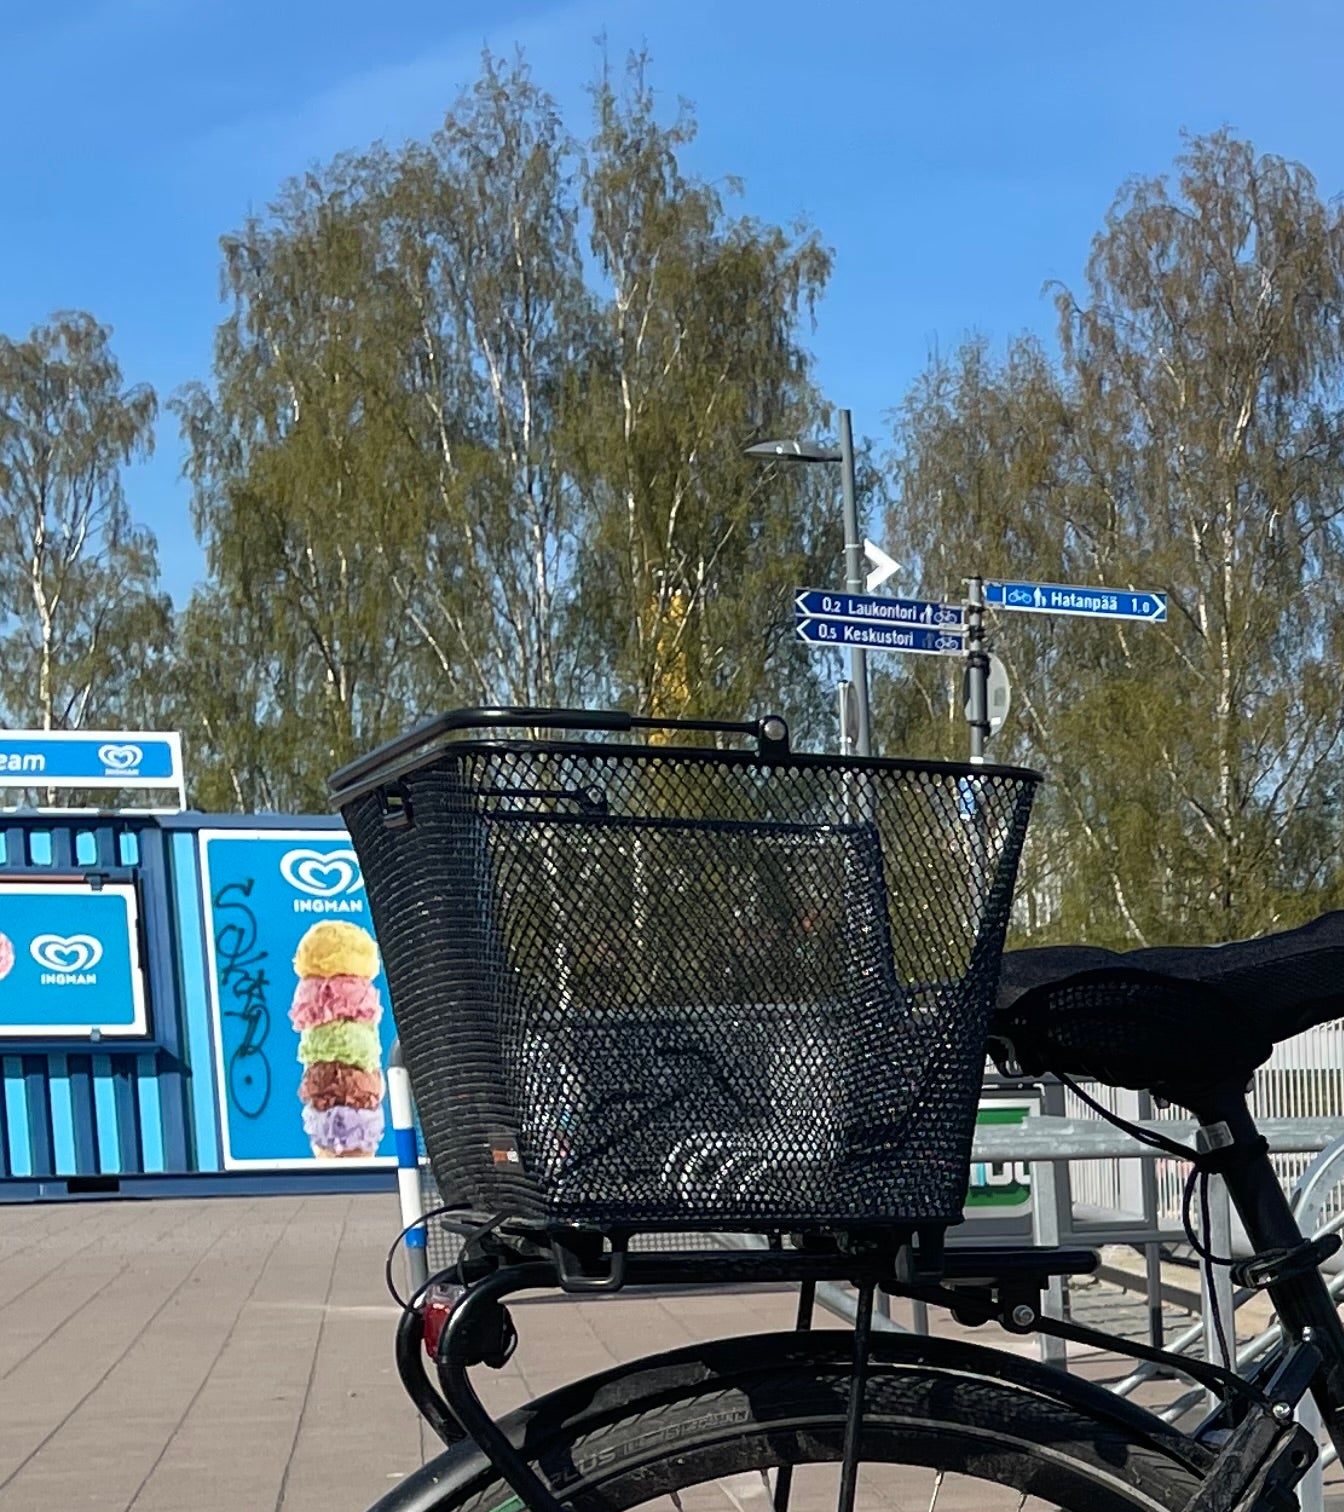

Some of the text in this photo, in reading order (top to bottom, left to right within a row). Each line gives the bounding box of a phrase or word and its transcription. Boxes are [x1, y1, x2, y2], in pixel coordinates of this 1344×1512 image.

[848, 600, 917, 621] Laukontori
[1051, 591, 1118, 611] Hatanpää
[844, 625, 914, 647] Keskustori
[0, 753, 46, 771] eam
[293, 898, 364, 913] INGMAN
[40, 973, 97, 986] INGMAN
